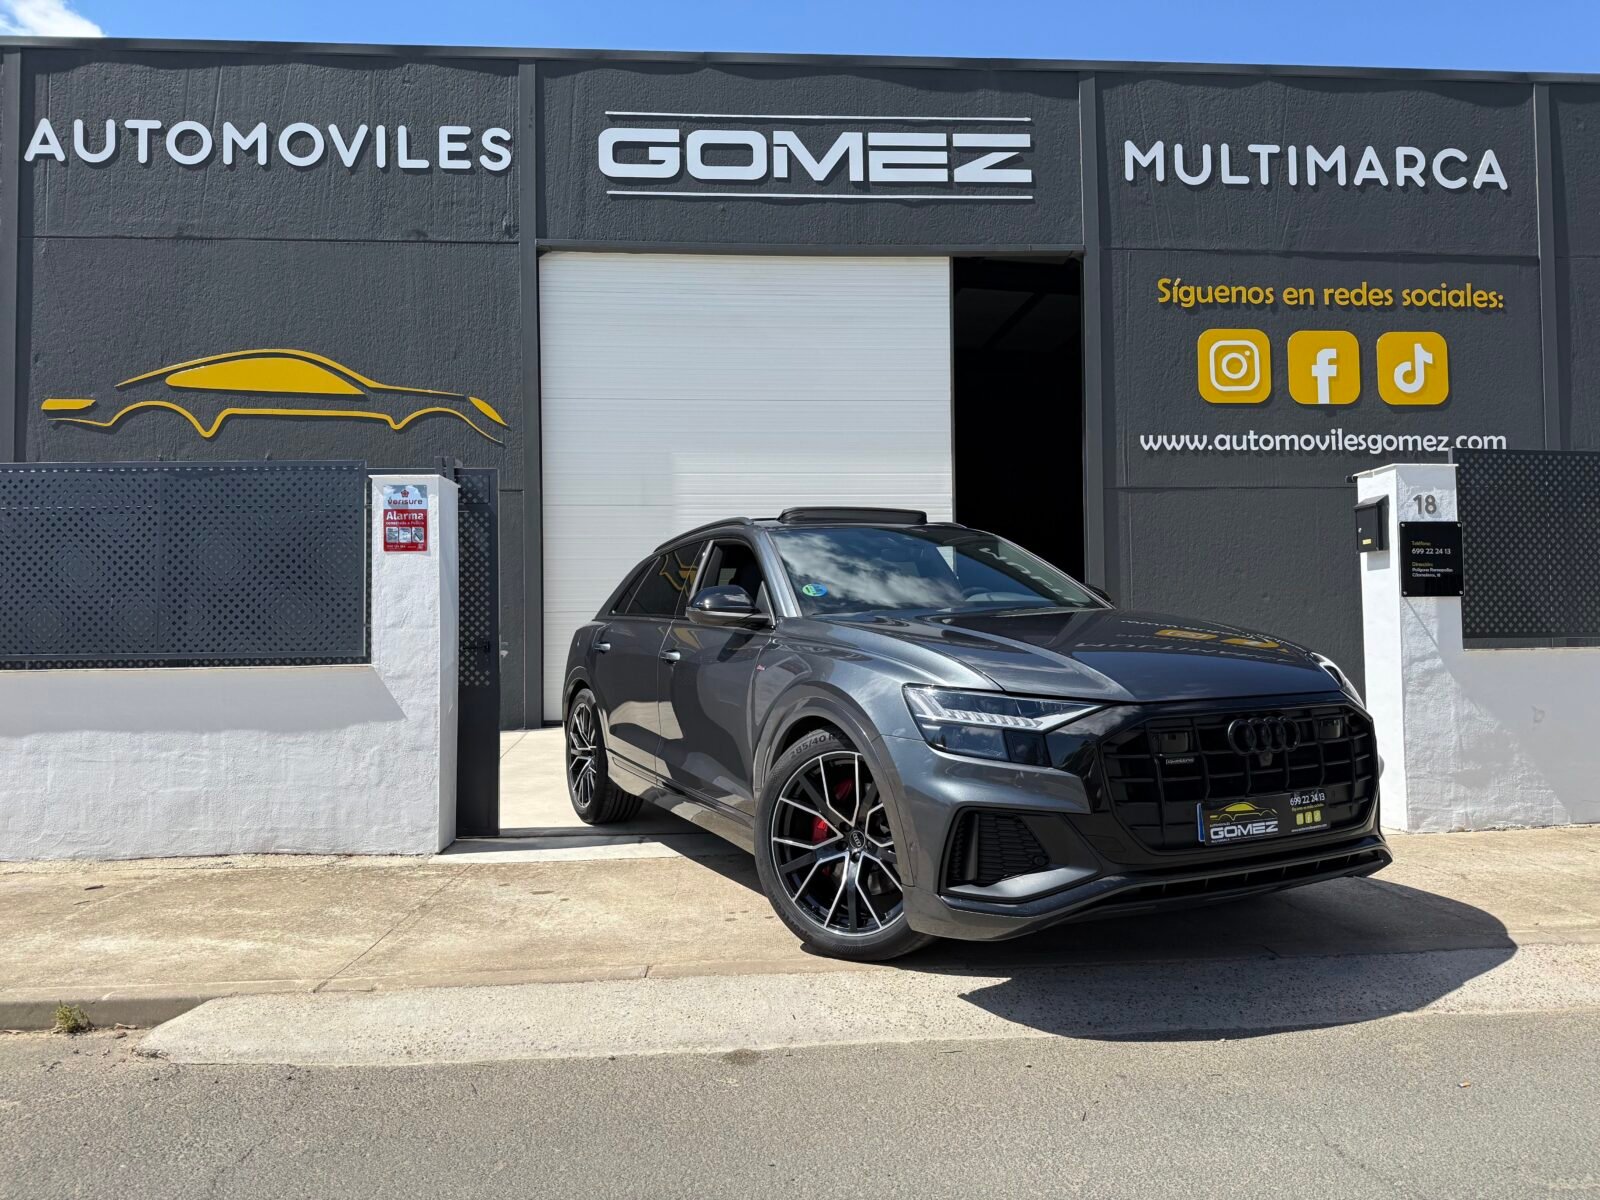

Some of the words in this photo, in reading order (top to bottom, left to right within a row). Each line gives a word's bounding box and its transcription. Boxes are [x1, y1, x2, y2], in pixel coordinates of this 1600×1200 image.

[24, 117, 512, 172] AUTOMOVILES
[598, 127, 1033, 183] GOMEZ
[1124, 140, 1508, 191] MULTIMARCA
[1156, 277, 1274, 309] Síguenos
[1282, 286, 1314, 306] en
[1323, 282, 1394, 307] redes
[1401, 283, 1504, 309] sociales:
[1139, 428, 1507, 455] www.automovilesgomez.com
[386, 511, 424, 521] Alarma
[1413, 494, 1437, 515] 18
[1411, 547, 1425, 555] 699
[1425, 547, 1434, 555] 22
[1435, 547, 1443, 555] 24
[1302, 795, 1311, 804] 22
[1318, 792, 1326, 801] 13
[1210, 821, 1279, 839] GOMEZ
